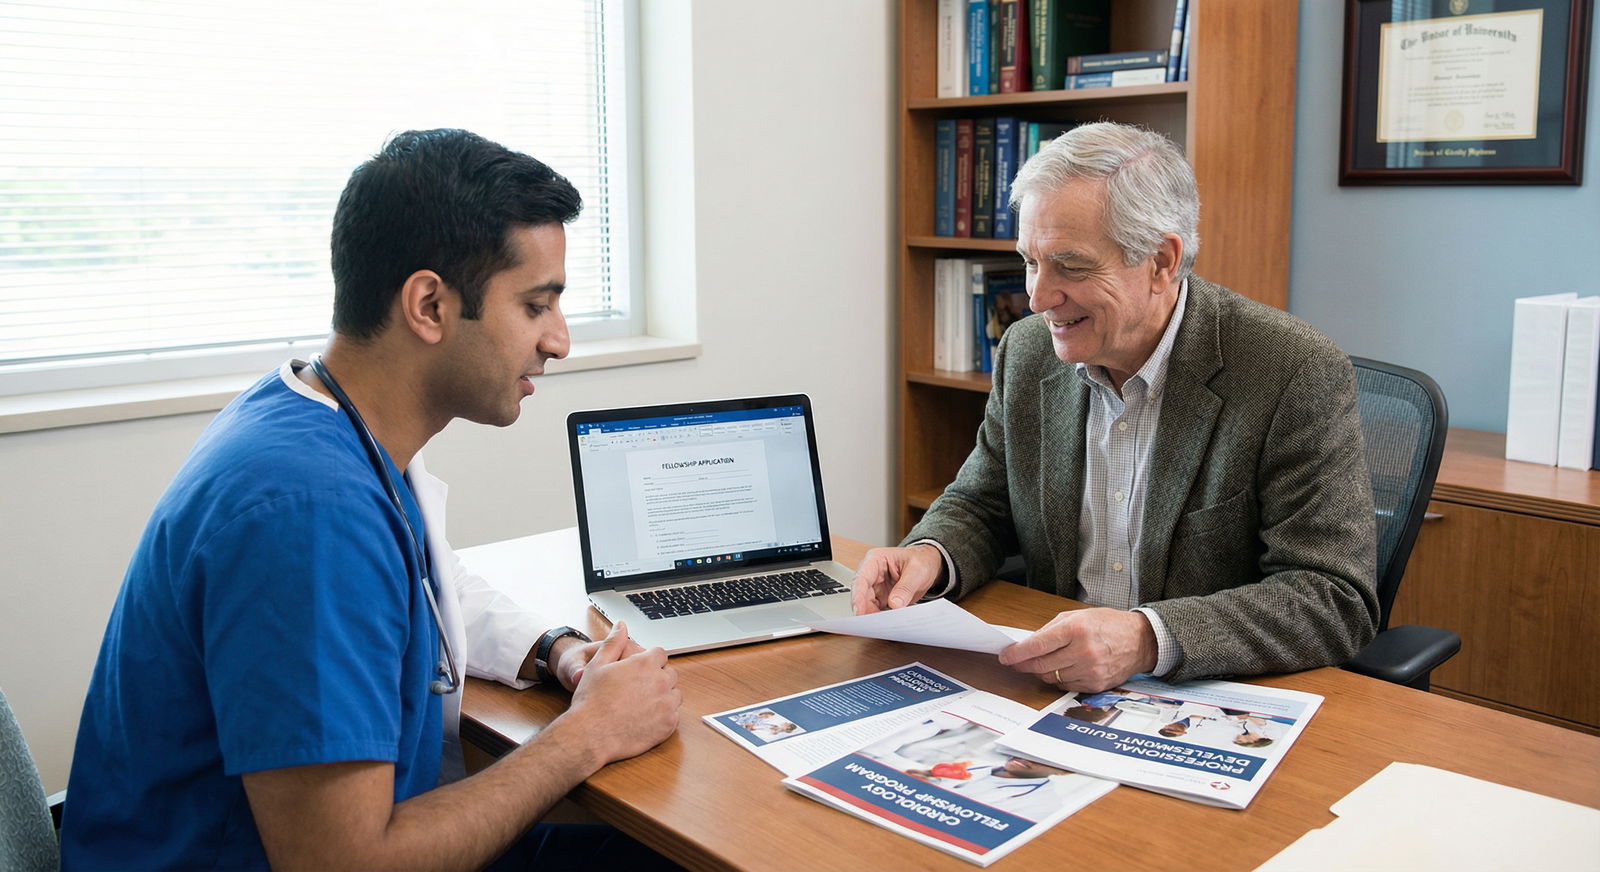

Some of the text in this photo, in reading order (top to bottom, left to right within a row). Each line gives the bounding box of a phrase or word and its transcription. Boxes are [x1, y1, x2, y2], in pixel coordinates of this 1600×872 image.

[662, 457, 735, 470] FELLOWSHIP APPLICATION
[1066, 723, 1118, 740] GUIDE
[1114, 742, 1245, 775] PROFESSIONAL
[844, 762, 1009, 831] FELLOWSHIP PROGRAM
[861, 783, 961, 826] CARDIOLOGY
